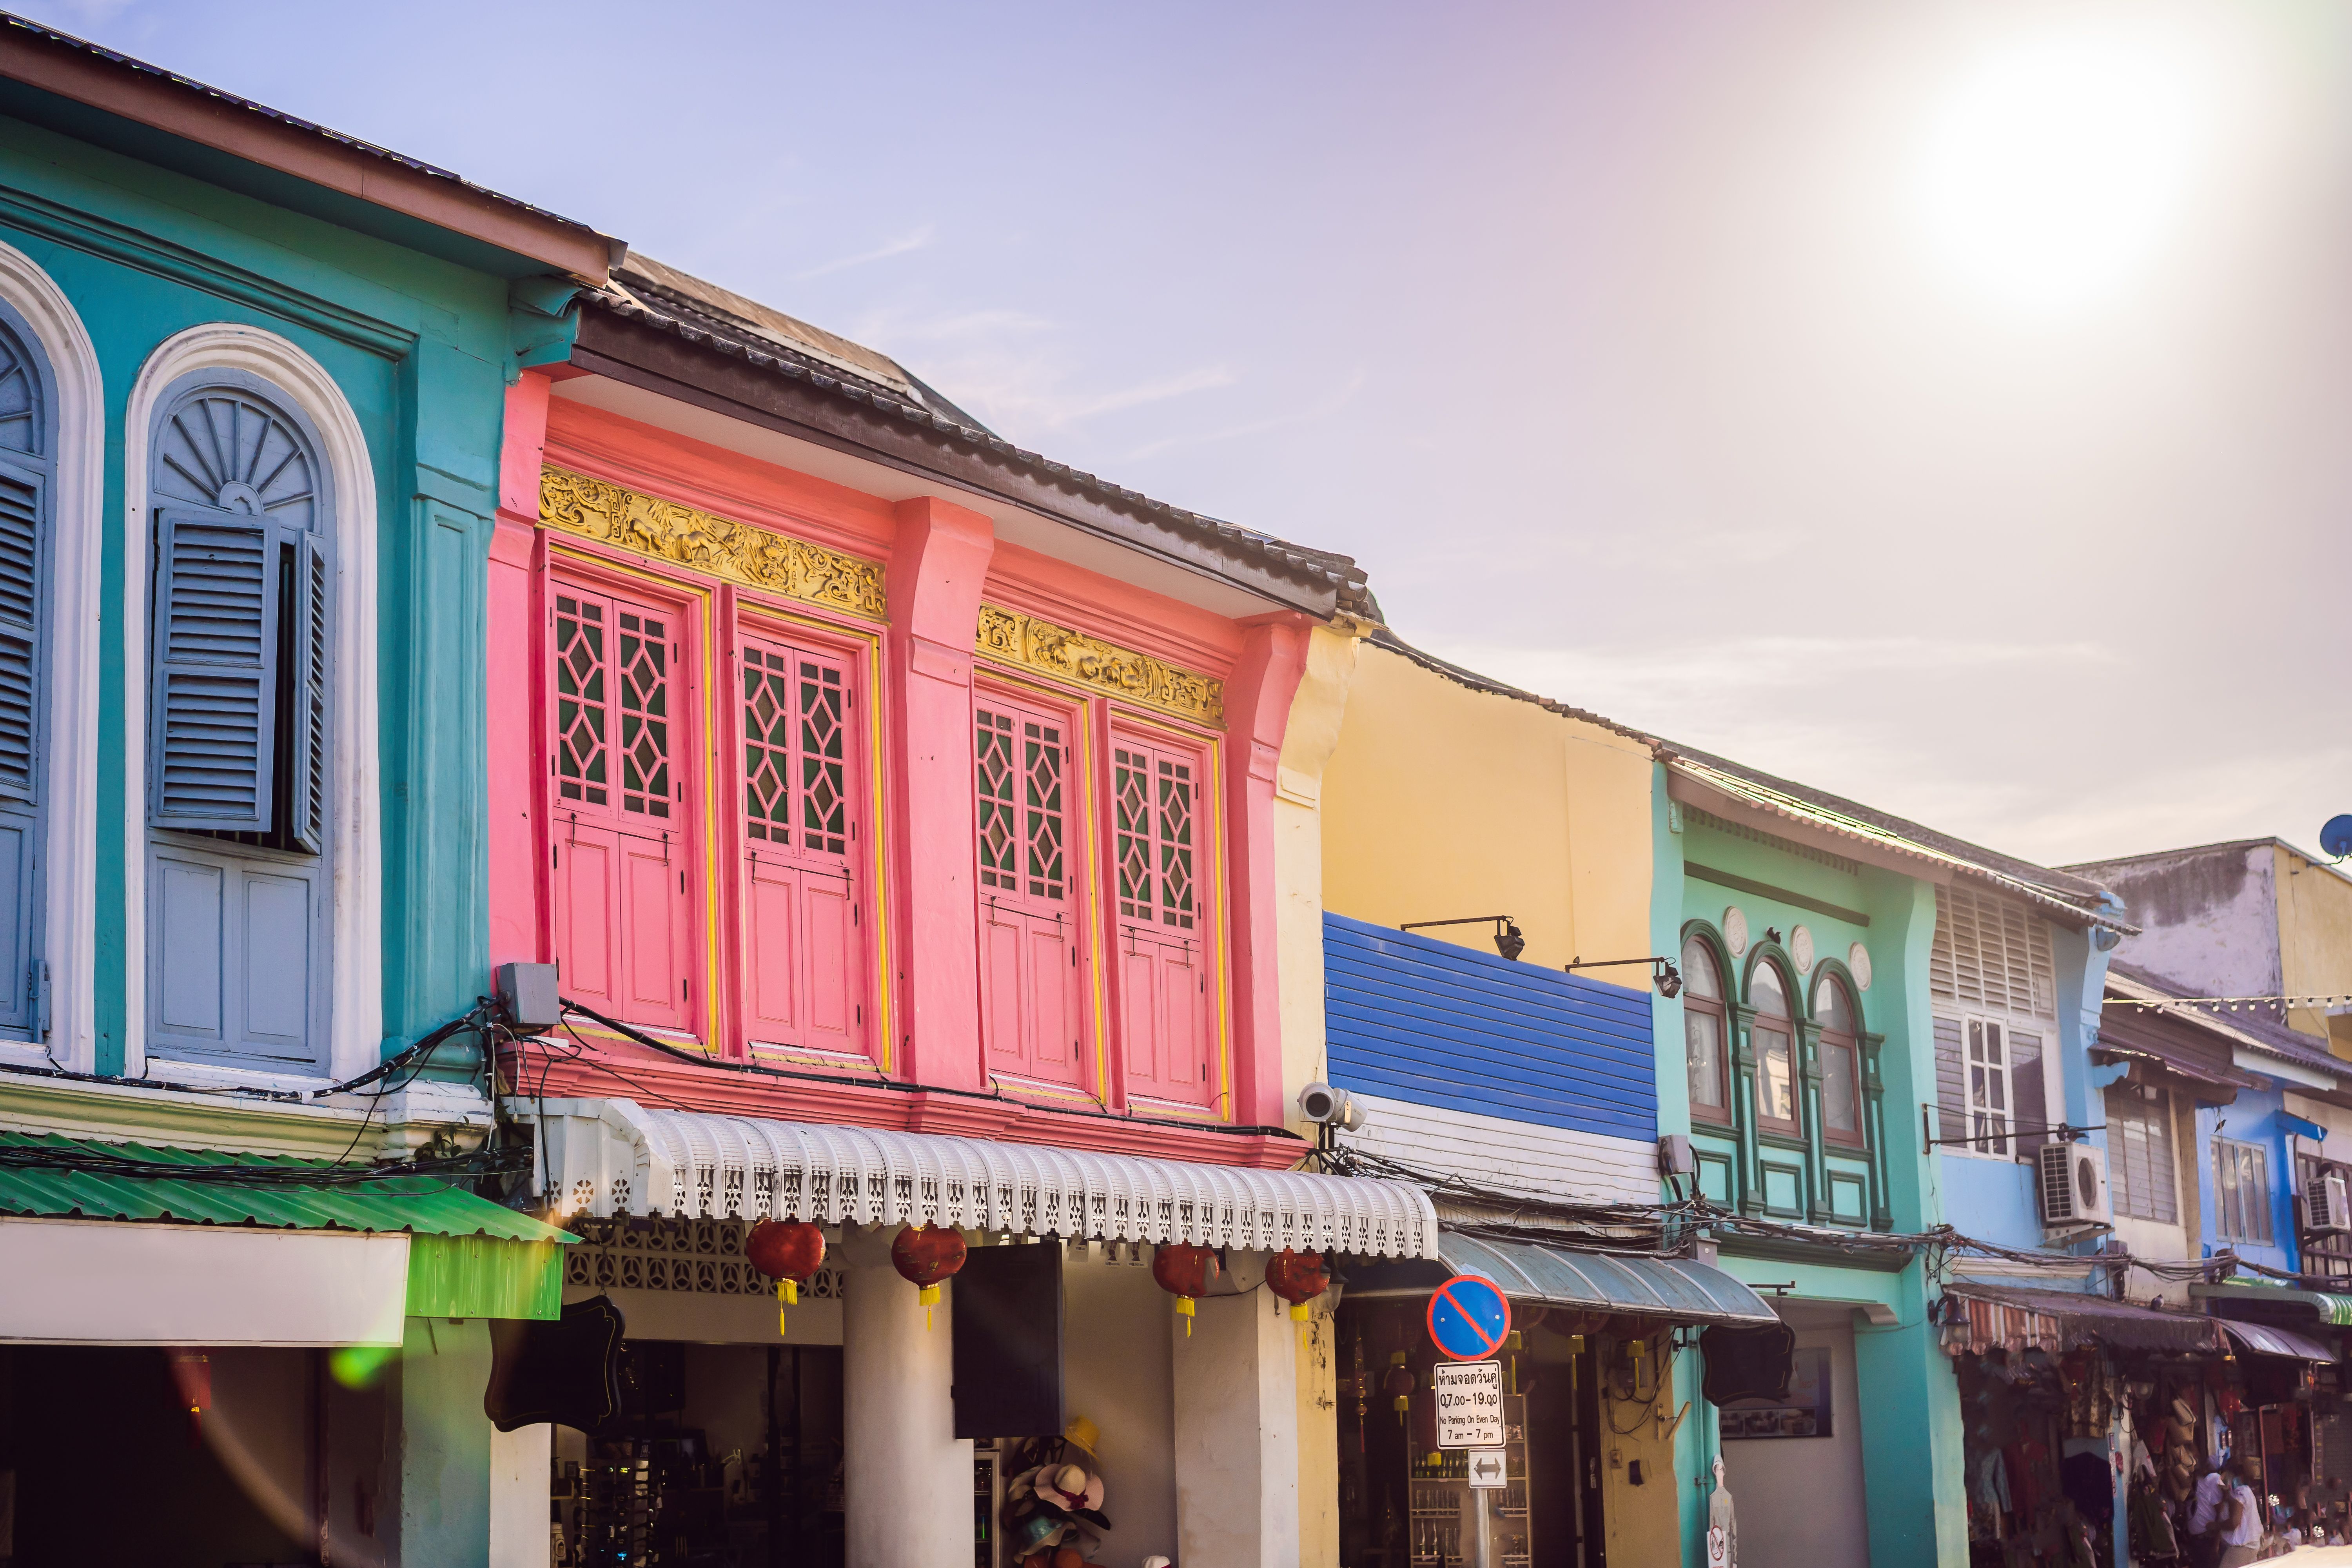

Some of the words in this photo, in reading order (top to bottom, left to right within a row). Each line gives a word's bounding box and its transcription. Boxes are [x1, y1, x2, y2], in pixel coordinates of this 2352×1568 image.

[1438, 1368, 1497, 1389] ห้ามจอดวันคู่
[1440, 1416, 1446, 1425] No
[1448, 1416, 1465, 1426] Parking
[1467, 1415, 1474, 1423] On
[1476, 1415, 1488, 1423] Even
[1490, 1414, 1499, 1424] Day
[1448, 1429, 1452, 1439] 7
[1475, 1428, 1481, 1438] 7
